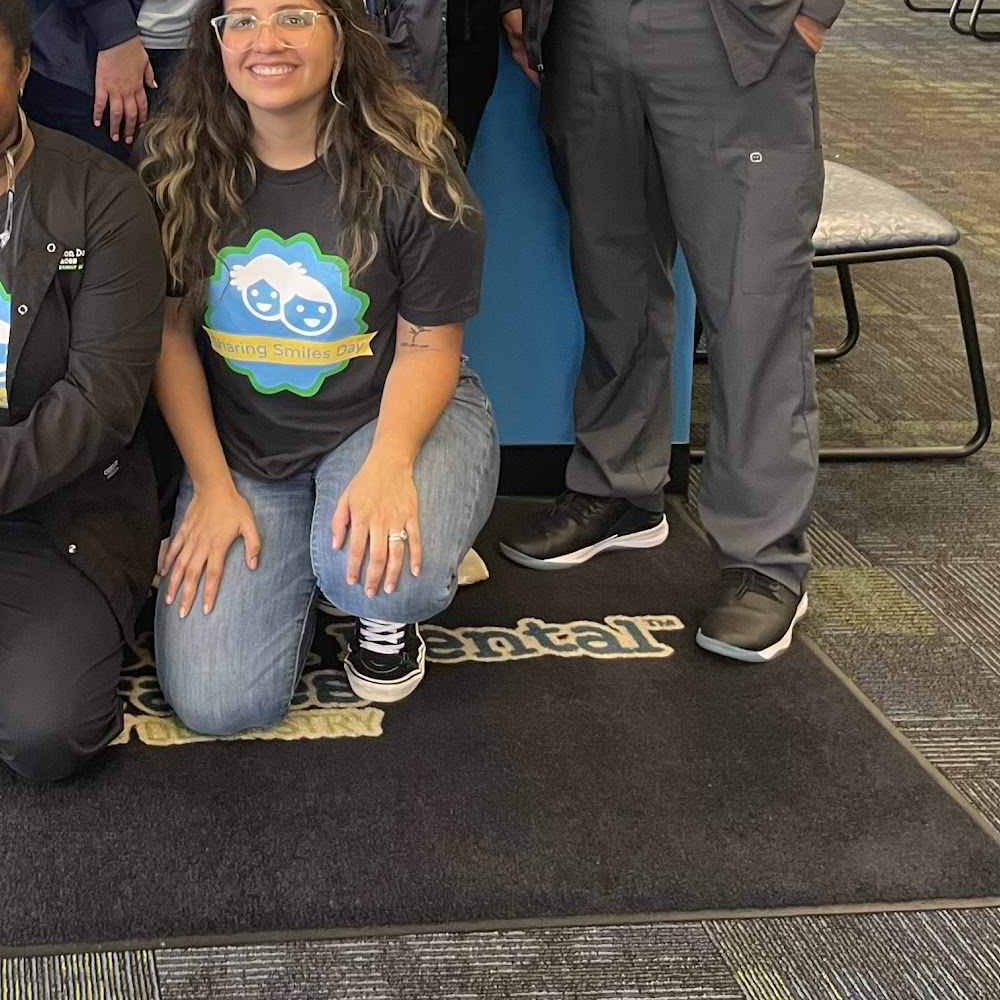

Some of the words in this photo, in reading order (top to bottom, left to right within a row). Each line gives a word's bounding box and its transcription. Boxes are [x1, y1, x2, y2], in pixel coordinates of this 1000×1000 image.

[212, 335, 267, 358] Sharing
[273, 343, 331, 360] Smiles
[336, 341, 366, 357] Day
